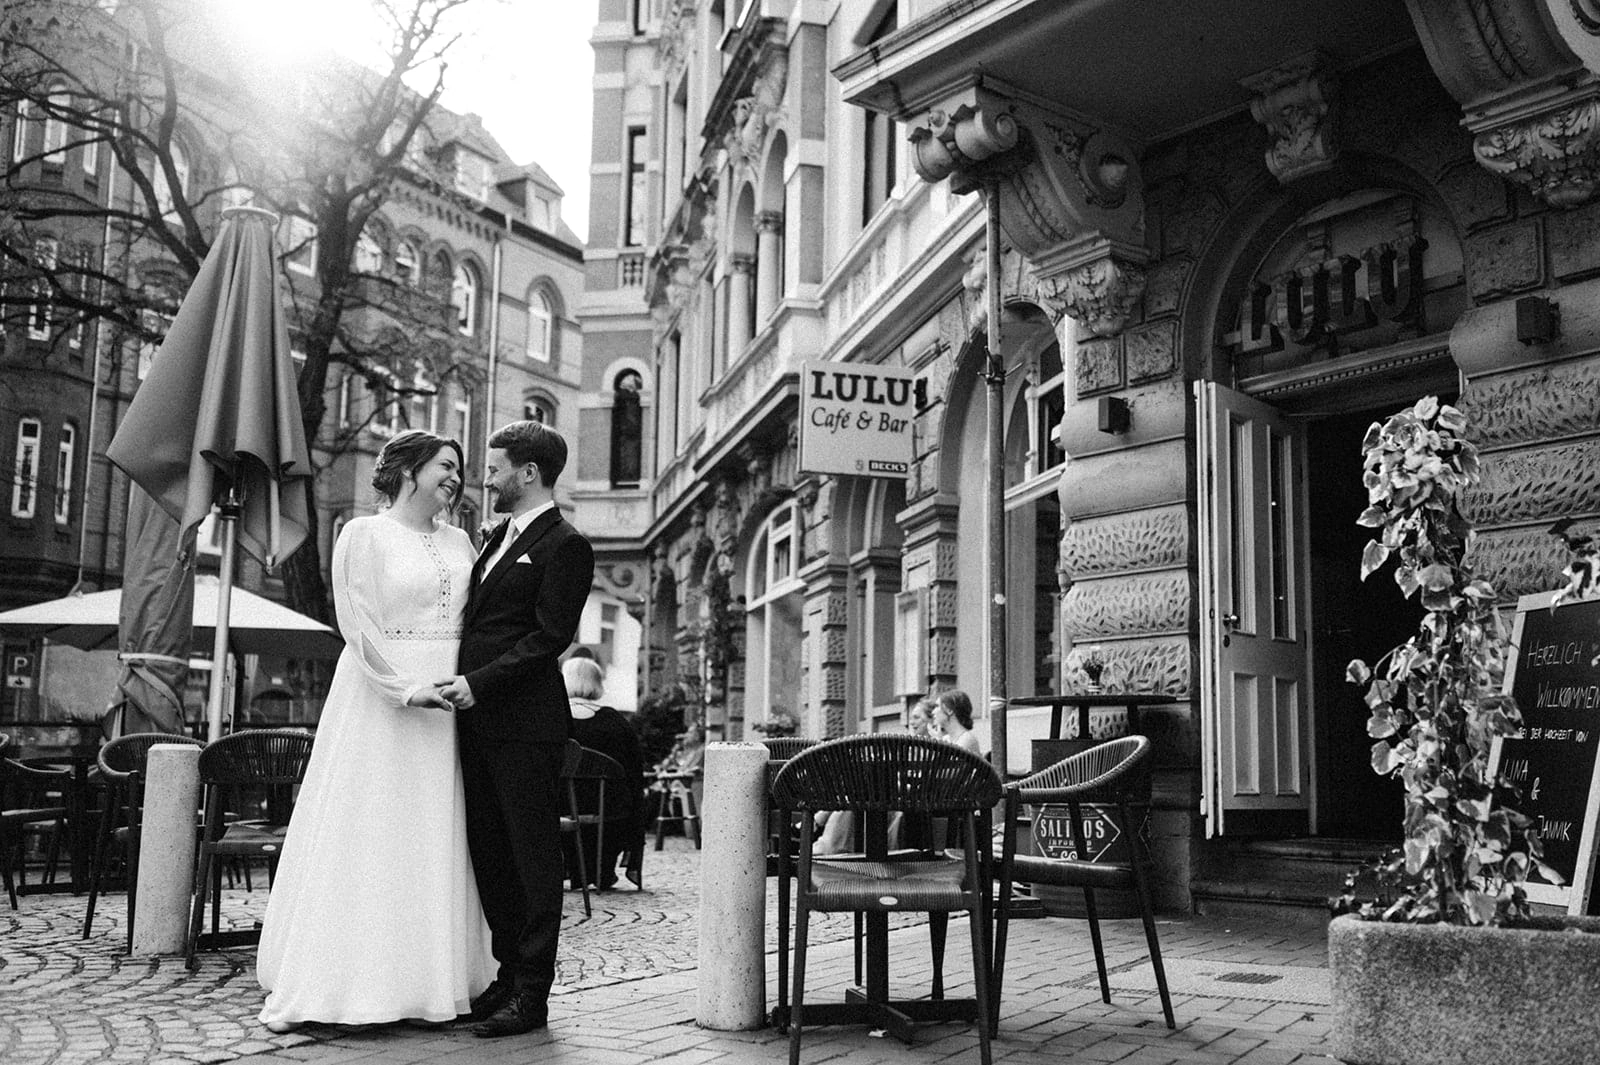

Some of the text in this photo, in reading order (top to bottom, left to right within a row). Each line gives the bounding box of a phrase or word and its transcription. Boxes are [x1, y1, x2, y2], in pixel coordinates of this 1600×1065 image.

[810, 370, 913, 406] LULU
[811, 406, 909, 434] Café & Bar
[14, 656, 28, 673] P
[1526, 641, 1583, 669] HERZLICH
[1575, 730, 1590, 742] VON
[1040, 819, 1105, 839] SALIOS
[1537, 815, 1572, 841] JANNIK
